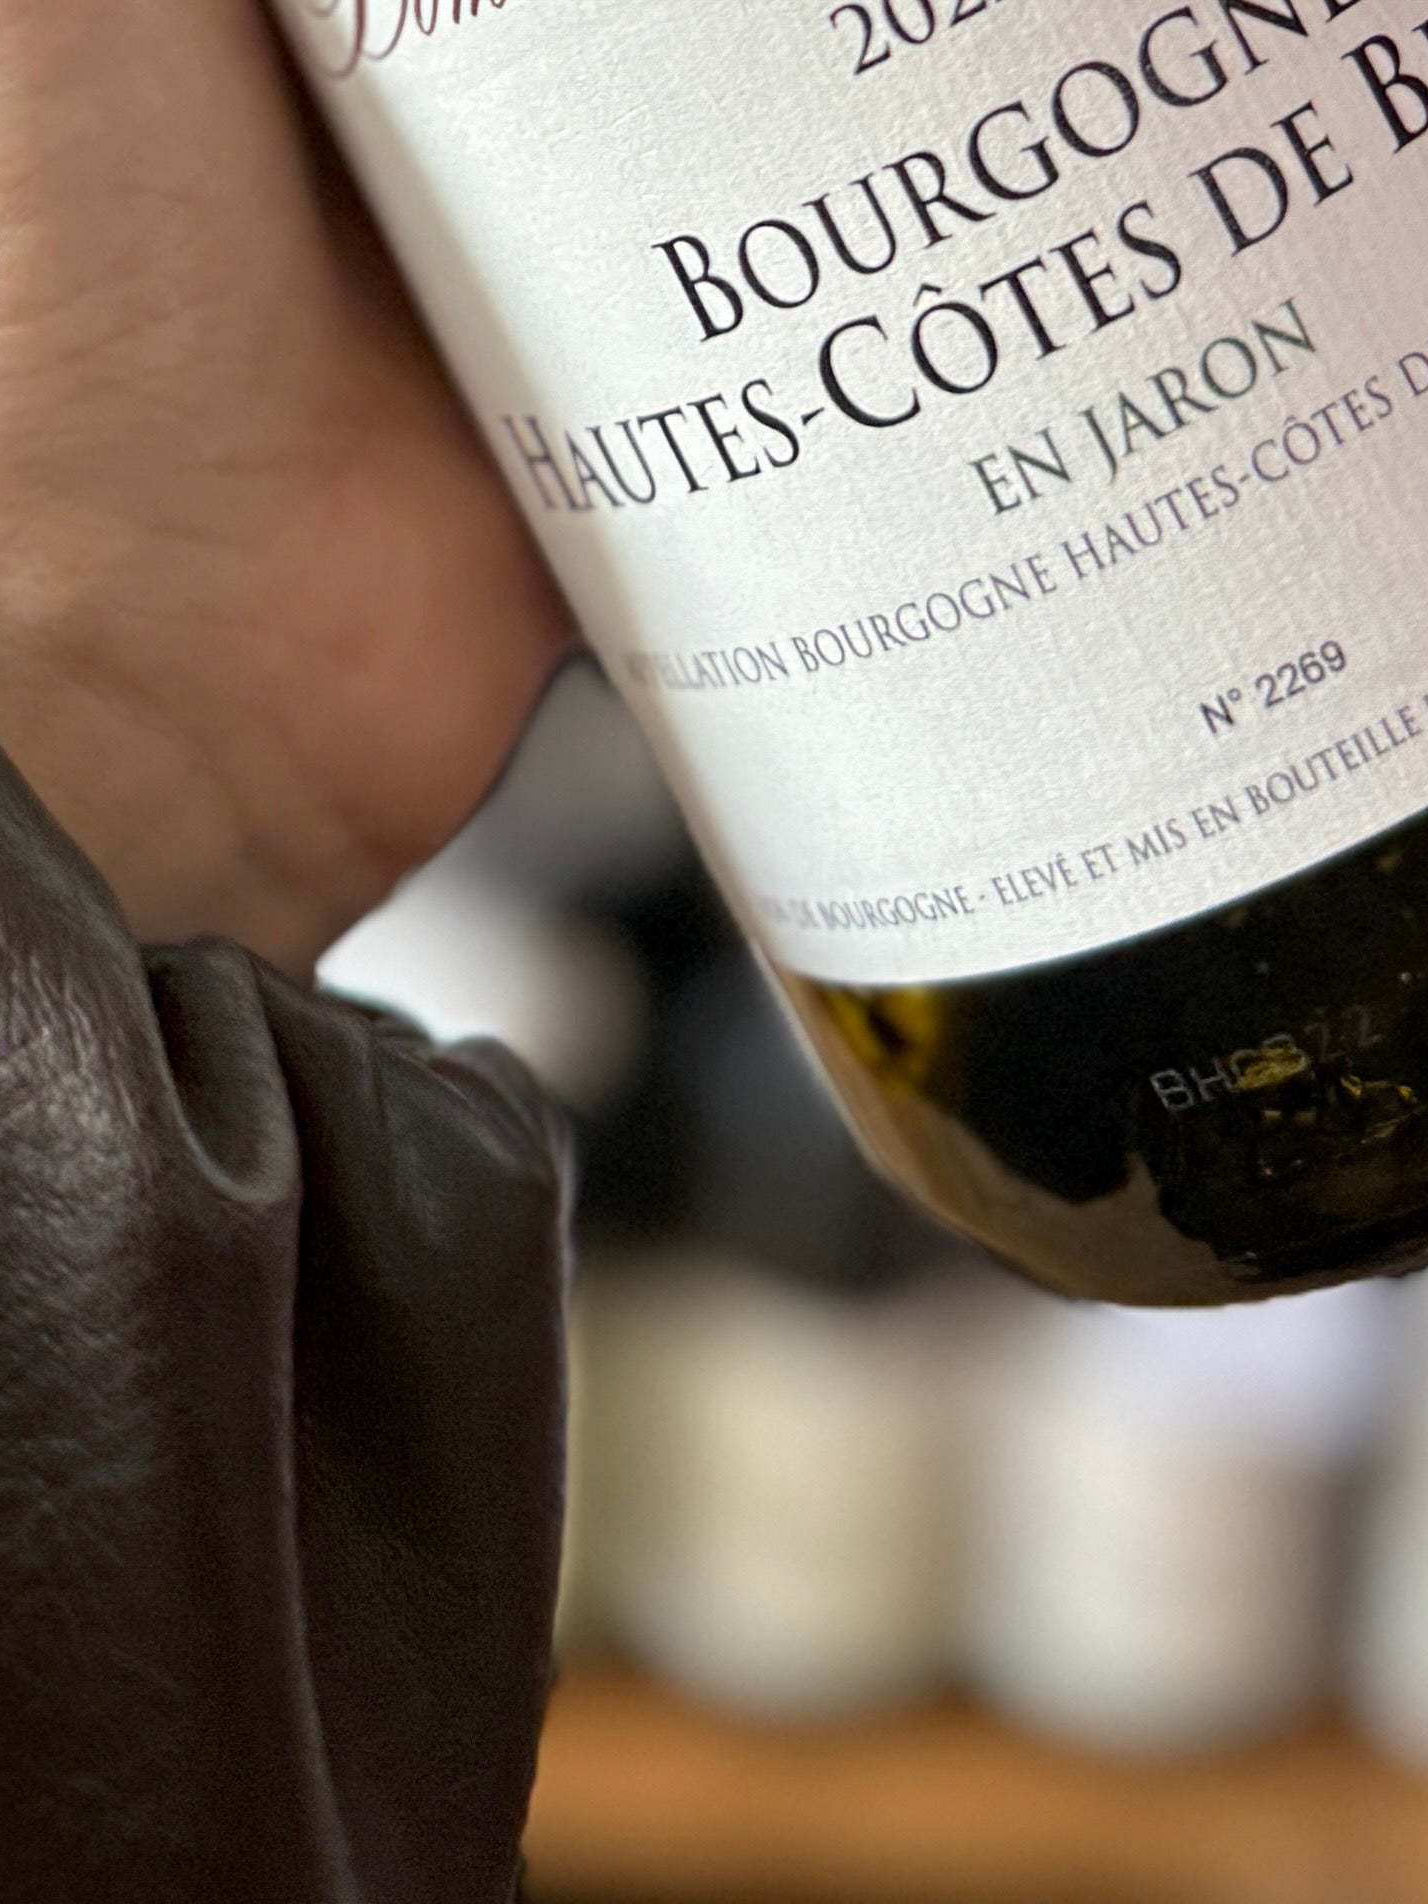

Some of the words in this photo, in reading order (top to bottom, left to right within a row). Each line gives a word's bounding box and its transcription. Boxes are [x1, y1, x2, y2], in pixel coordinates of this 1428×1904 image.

[502, 201, 1183, 512] HAUTES-CÔTES
[1188, 99, 1355, 257] DE
[968, 428, 1072, 517] EN
[1079, 296, 1318, 485] JARON
[791, 554, 1057, 675] BOURGOGNE
[1061, 374, 1394, 582] HAUTES-CÔTES
[1254, 640, 1348, 710] 2269
[819, 884, 976, 932] BOURGOGNE
[1080, 842, 1120, 882] ET
[1125, 816, 1189, 869] MIS
[1192, 795, 1242, 840] EN
[1244, 704, 1423, 816] BOUTEILLE
